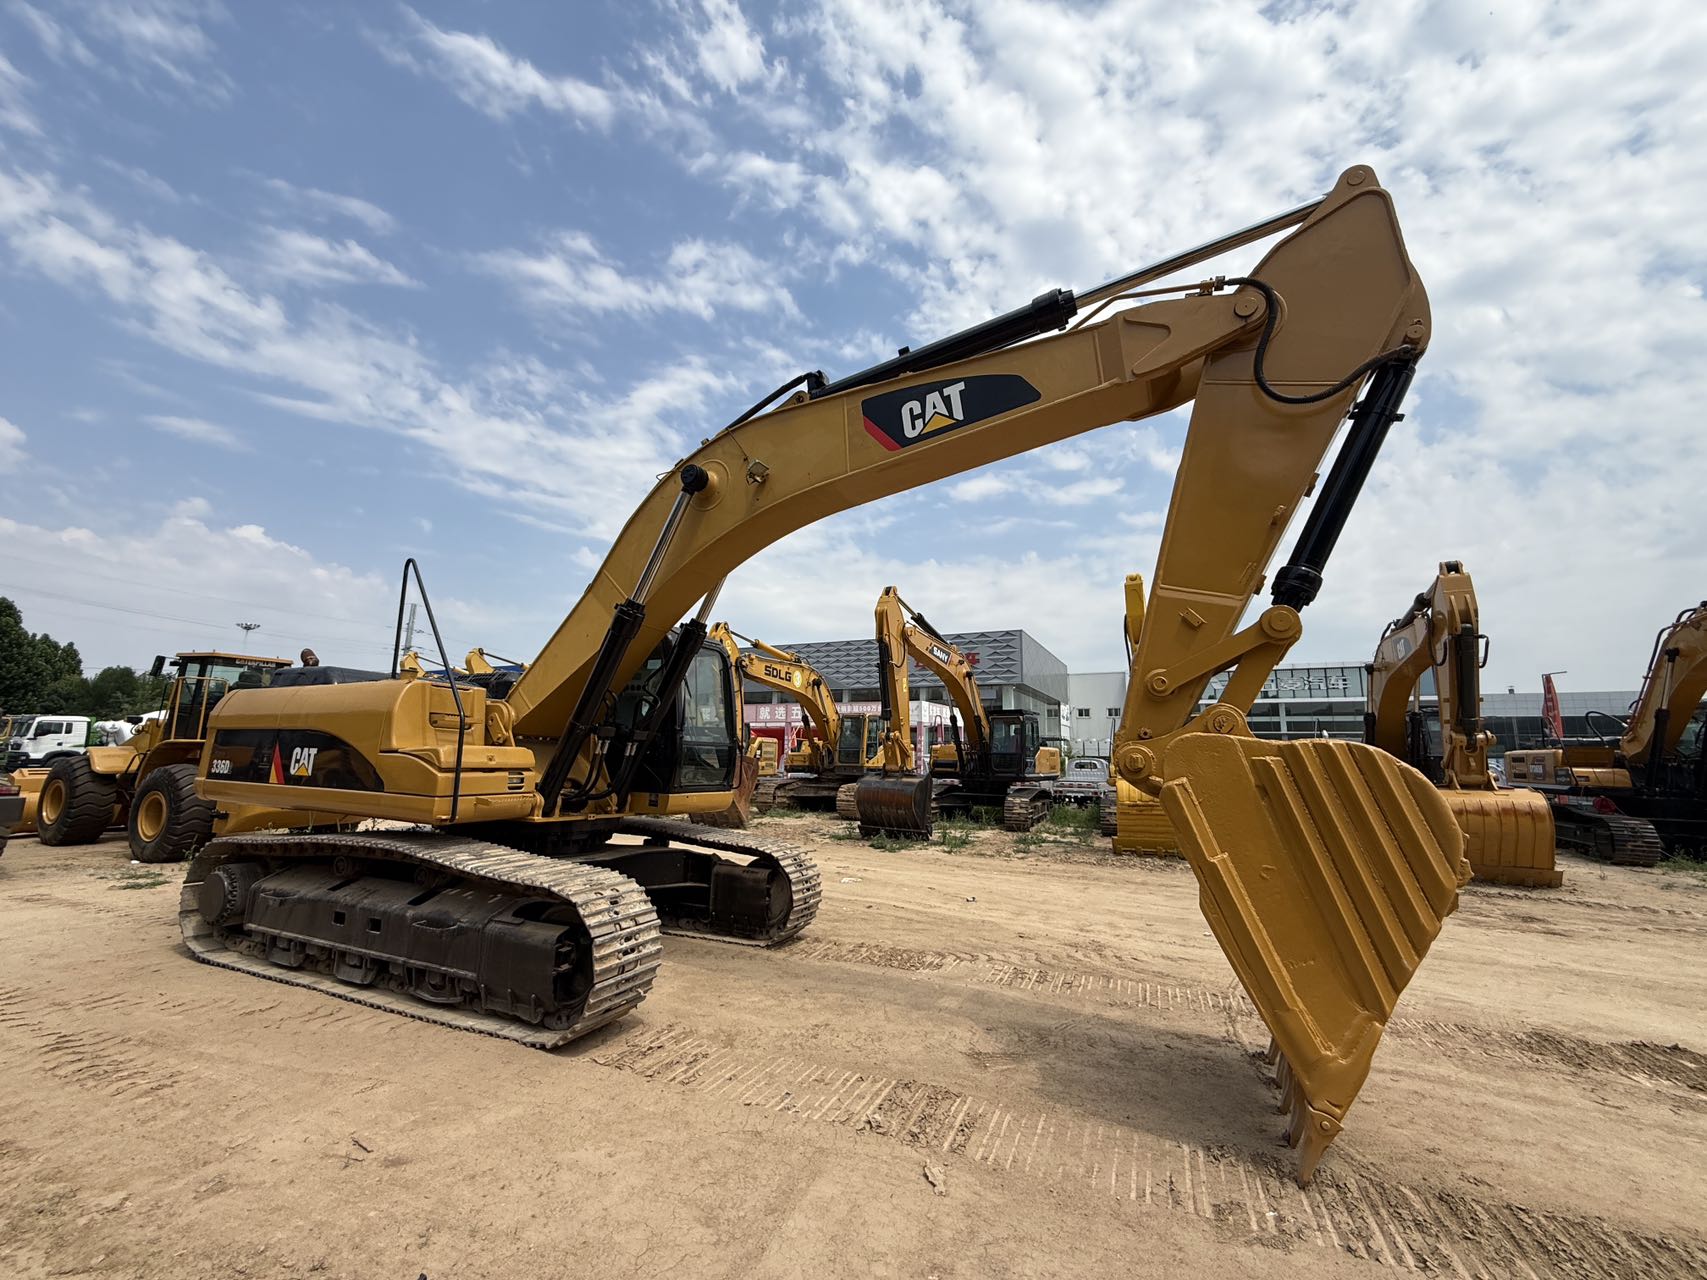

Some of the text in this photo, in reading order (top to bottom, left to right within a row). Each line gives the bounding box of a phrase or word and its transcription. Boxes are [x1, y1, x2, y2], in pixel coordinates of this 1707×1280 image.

[901, 381, 966, 439] CAT
[933, 646, 948, 663] SANY
[764, 664, 792, 683] SDLG
[289, 747, 318, 777] CAT
